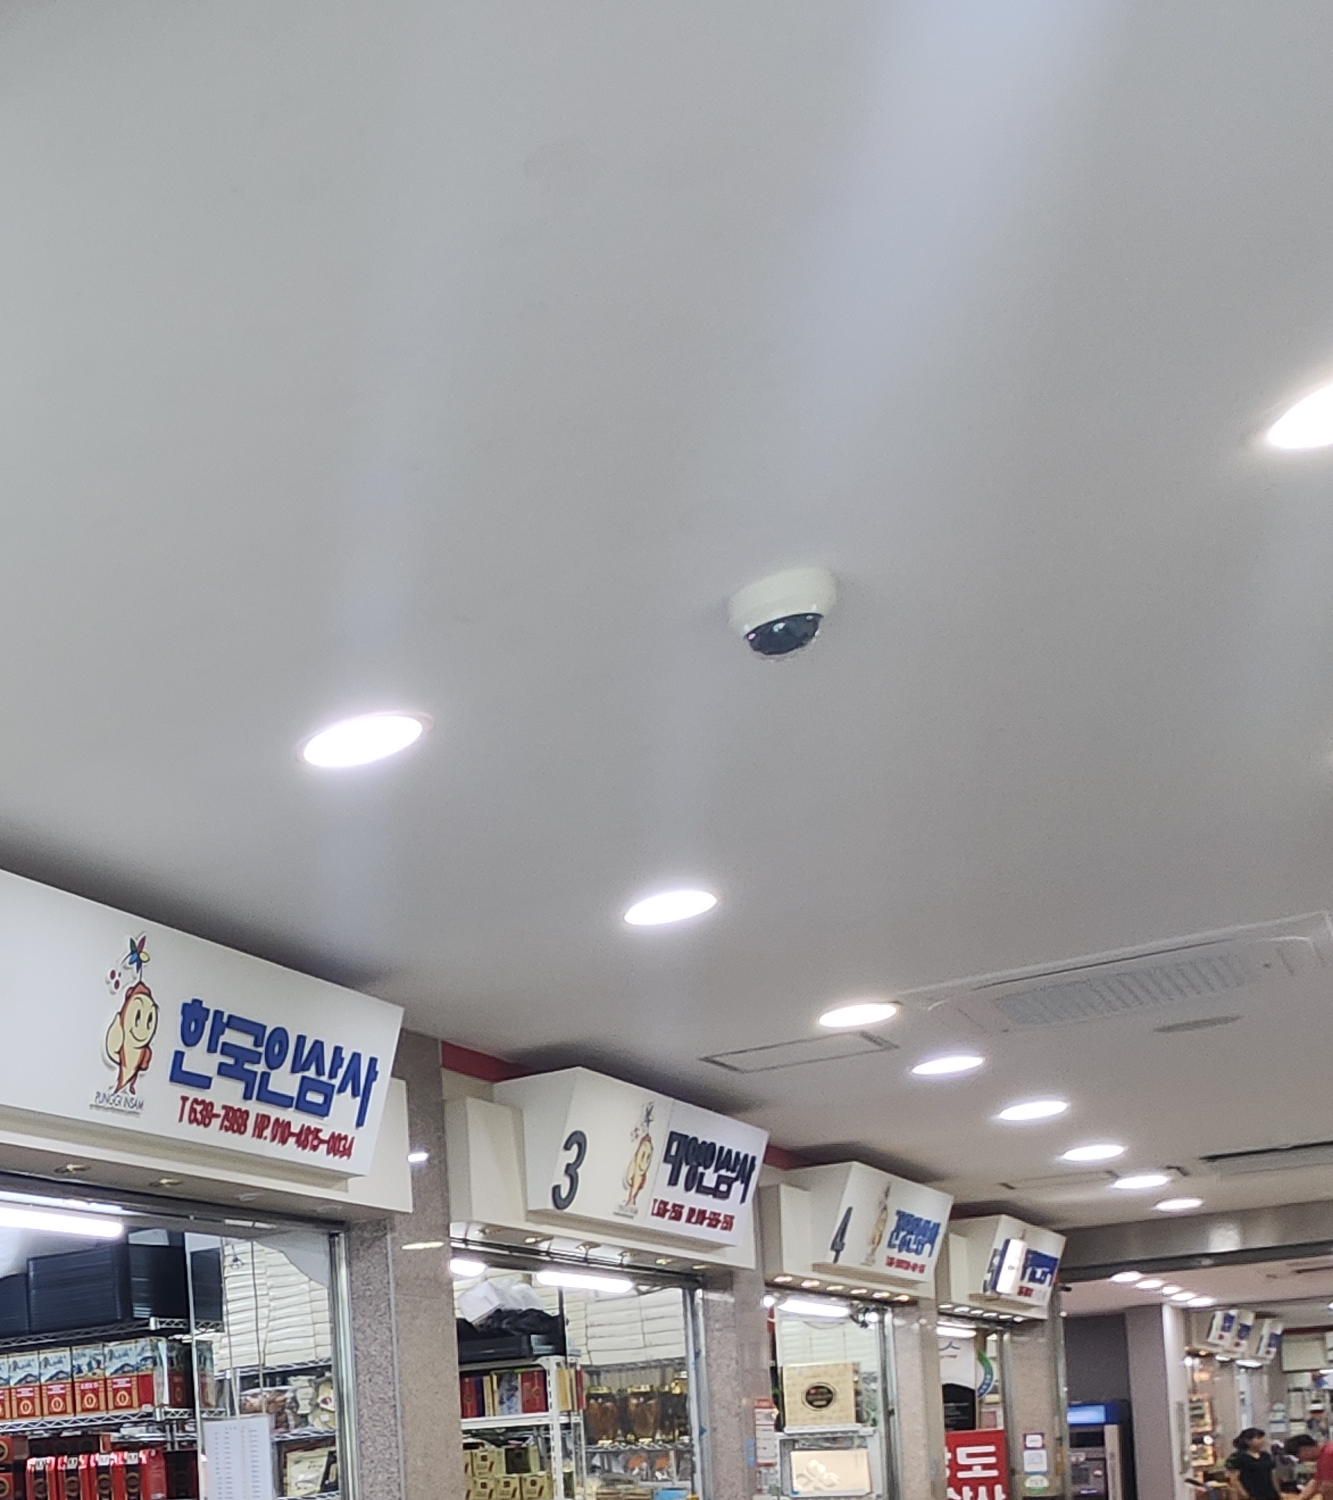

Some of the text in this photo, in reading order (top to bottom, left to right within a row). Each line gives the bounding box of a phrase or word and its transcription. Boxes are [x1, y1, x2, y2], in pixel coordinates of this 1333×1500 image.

[169, 998, 378, 1129] 한국인삼사
[551, 1130, 587, 1210] 3
[830, 1206, 853, 1264] 4
